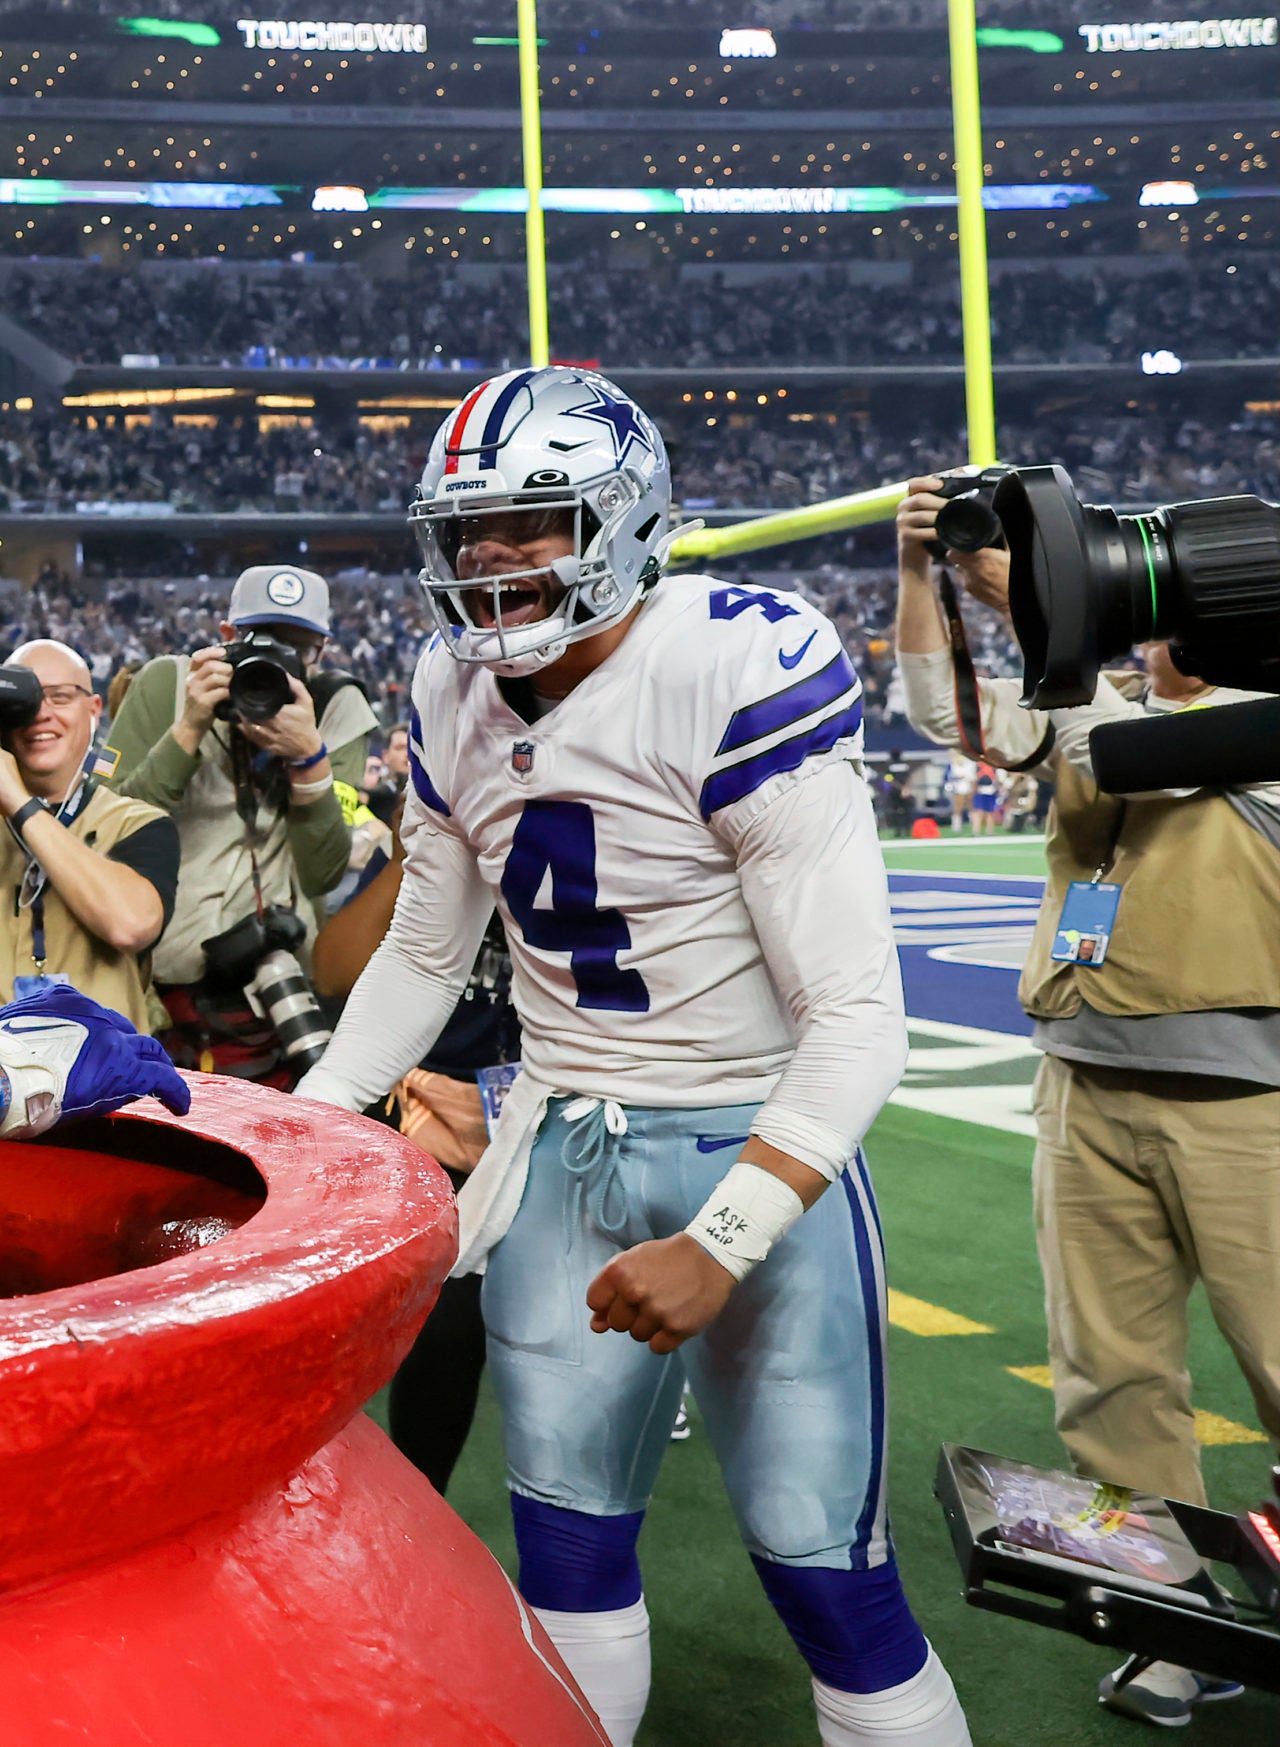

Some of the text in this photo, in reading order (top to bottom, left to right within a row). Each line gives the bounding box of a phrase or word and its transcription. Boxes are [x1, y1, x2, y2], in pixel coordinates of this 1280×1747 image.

[237, 19, 427, 53] TOUCHDOWN
[1078, 17, 1278, 53] TOUCHDOWN
[675, 188, 836, 213] TOUCHDOWN
[445, 480, 487, 492] COWBOYS
[709, 586, 802, 624] 4
[500, 799, 651, 1013] 4
[713, 1206, 748, 1232] ASK
